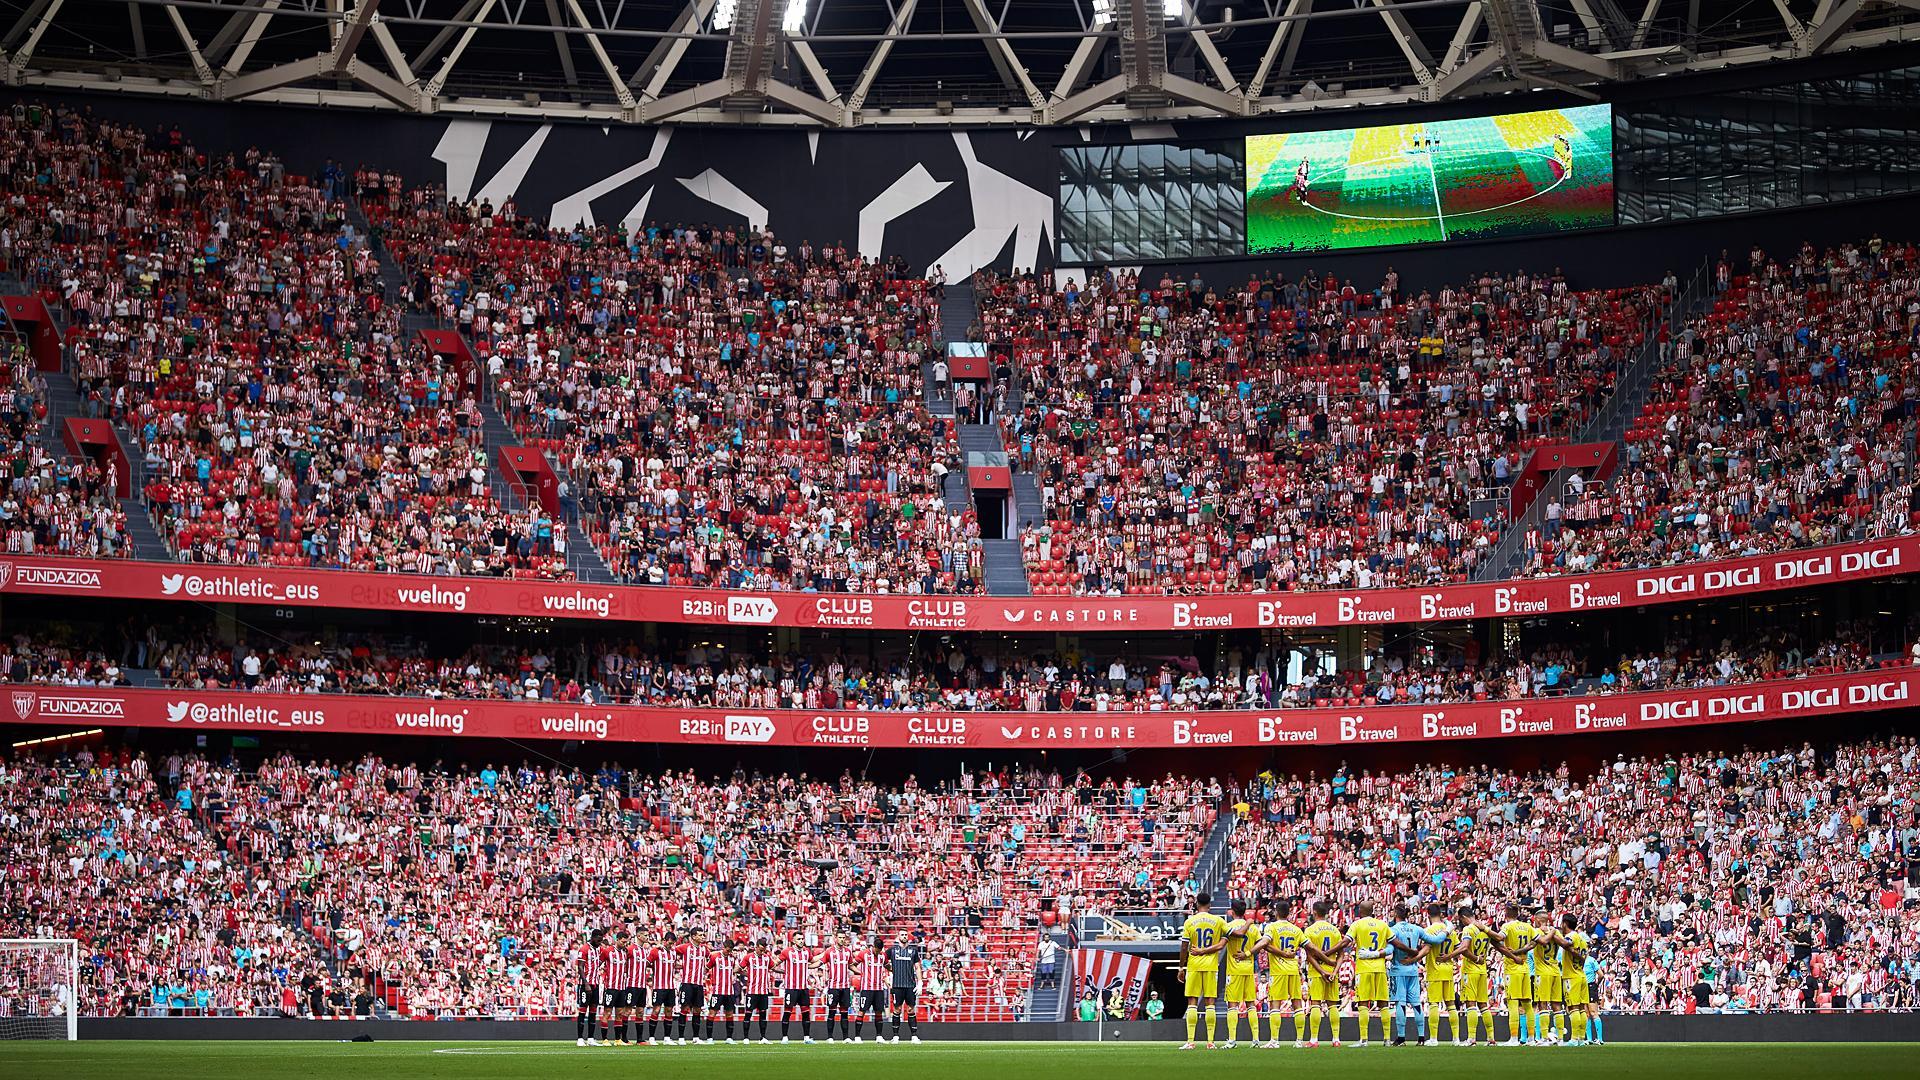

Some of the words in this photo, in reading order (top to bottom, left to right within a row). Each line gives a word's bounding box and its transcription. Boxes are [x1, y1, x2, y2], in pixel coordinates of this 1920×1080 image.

[16, 569, 101, 586] FUNDAZIOA
[1637, 575, 1694, 596] DIGI
[1705, 567, 1760, 589] DIGI
[1775, 557, 1831, 580] DIGI
[1841, 548, 1899, 572] DIGI
[184, 575, 319, 600] @athletic_eus
[398, 584, 470, 611] vueling
[544, 591, 614, 617] vueling
[1513, 598, 1547, 612] travel
[1587, 592, 1620, 606] travel
[734, 602, 763, 617] PAY
[816, 598, 873, 614] CLUB
[908, 601, 966, 616] CLUB
[1439, 603, 1474, 617] travel
[1034, 608, 1137, 622] CASTORE
[1193, 613, 1232, 626] travel
[1278, 612, 1316, 625] travel
[1358, 608, 1394, 621] travel
[1641, 700, 1699, 720] DIGI
[1709, 695, 1764, 715] DIGI
[1782, 688, 1839, 709] DIGI
[1849, 682, 1907, 703] DIGI
[39, 701, 124, 717] FUNDAZIOA
[190, 702, 324, 726] @athletic_eus
[396, 707, 468, 734] vueling
[542, 712, 611, 738] vueling
[813, 717, 869, 732] CLUB
[908, 718, 966, 733] CLUB
[1519, 718, 1553, 732] travel
[1593, 713, 1626, 728] travel
[731, 722, 761, 736] PAY
[1031, 726, 1135, 739] CASTORE
[1193, 730, 1232, 743] travel
[1278, 728, 1317, 741] travel
[1359, 726, 1397, 740] travel
[1441, 722, 1476, 736] travel
[1196, 928, 1213, 948] 16
[1280, 936, 1295, 951] 15
[1369, 932, 1378, 951] 3
[1518, 934, 1528, 949] 11
